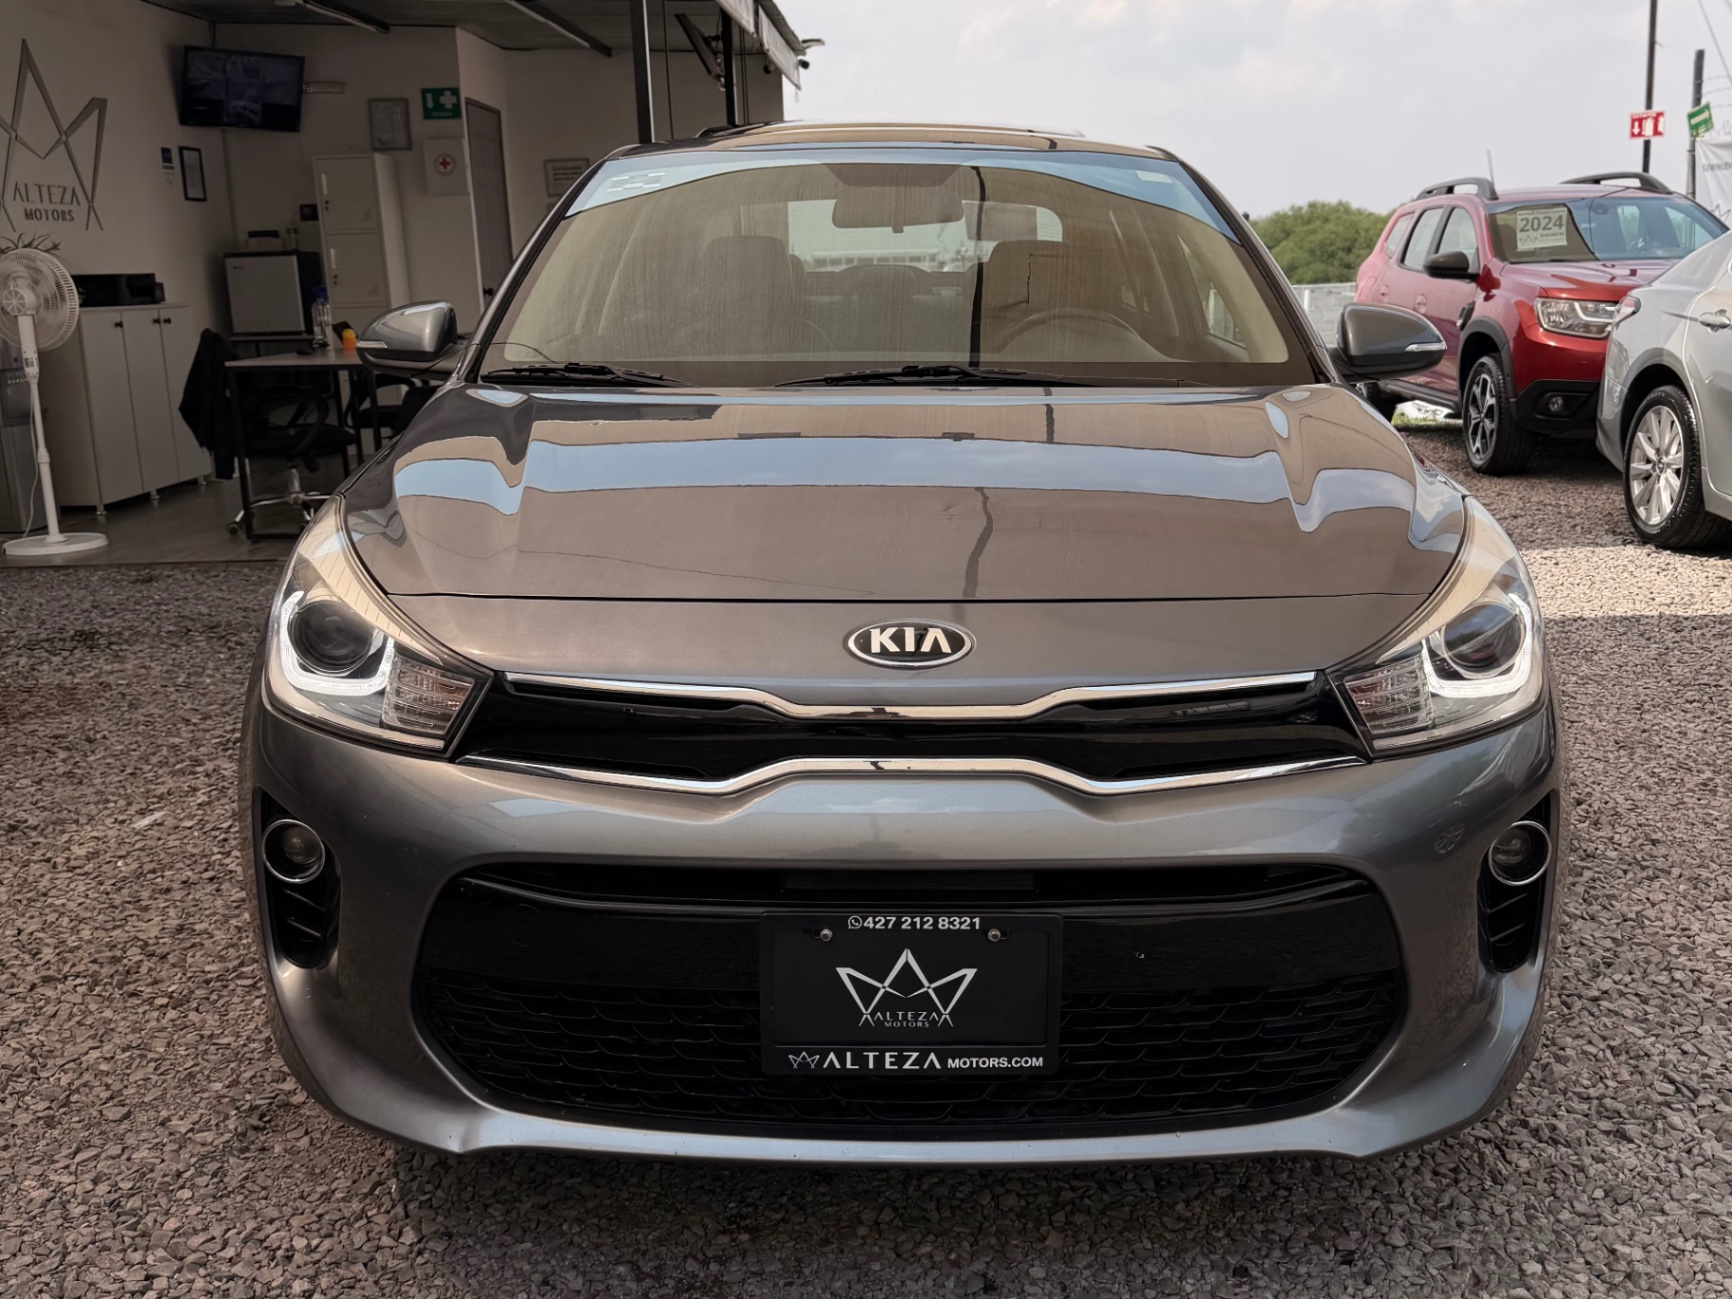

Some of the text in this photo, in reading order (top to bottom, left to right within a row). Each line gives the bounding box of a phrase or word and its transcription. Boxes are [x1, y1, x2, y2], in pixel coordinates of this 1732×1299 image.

[13, 181, 81, 206] ALTEZA
[24, 208, 75, 222] MOTORS
[1519, 215, 1564, 233] 2024
[869, 626, 952, 654] KIA
[863, 916, 980, 929] 427 212 8321
[874, 1011, 939, 1020] ALTEZA
[823, 1051, 1044, 1069] ALTEZA MOTORS.COM
